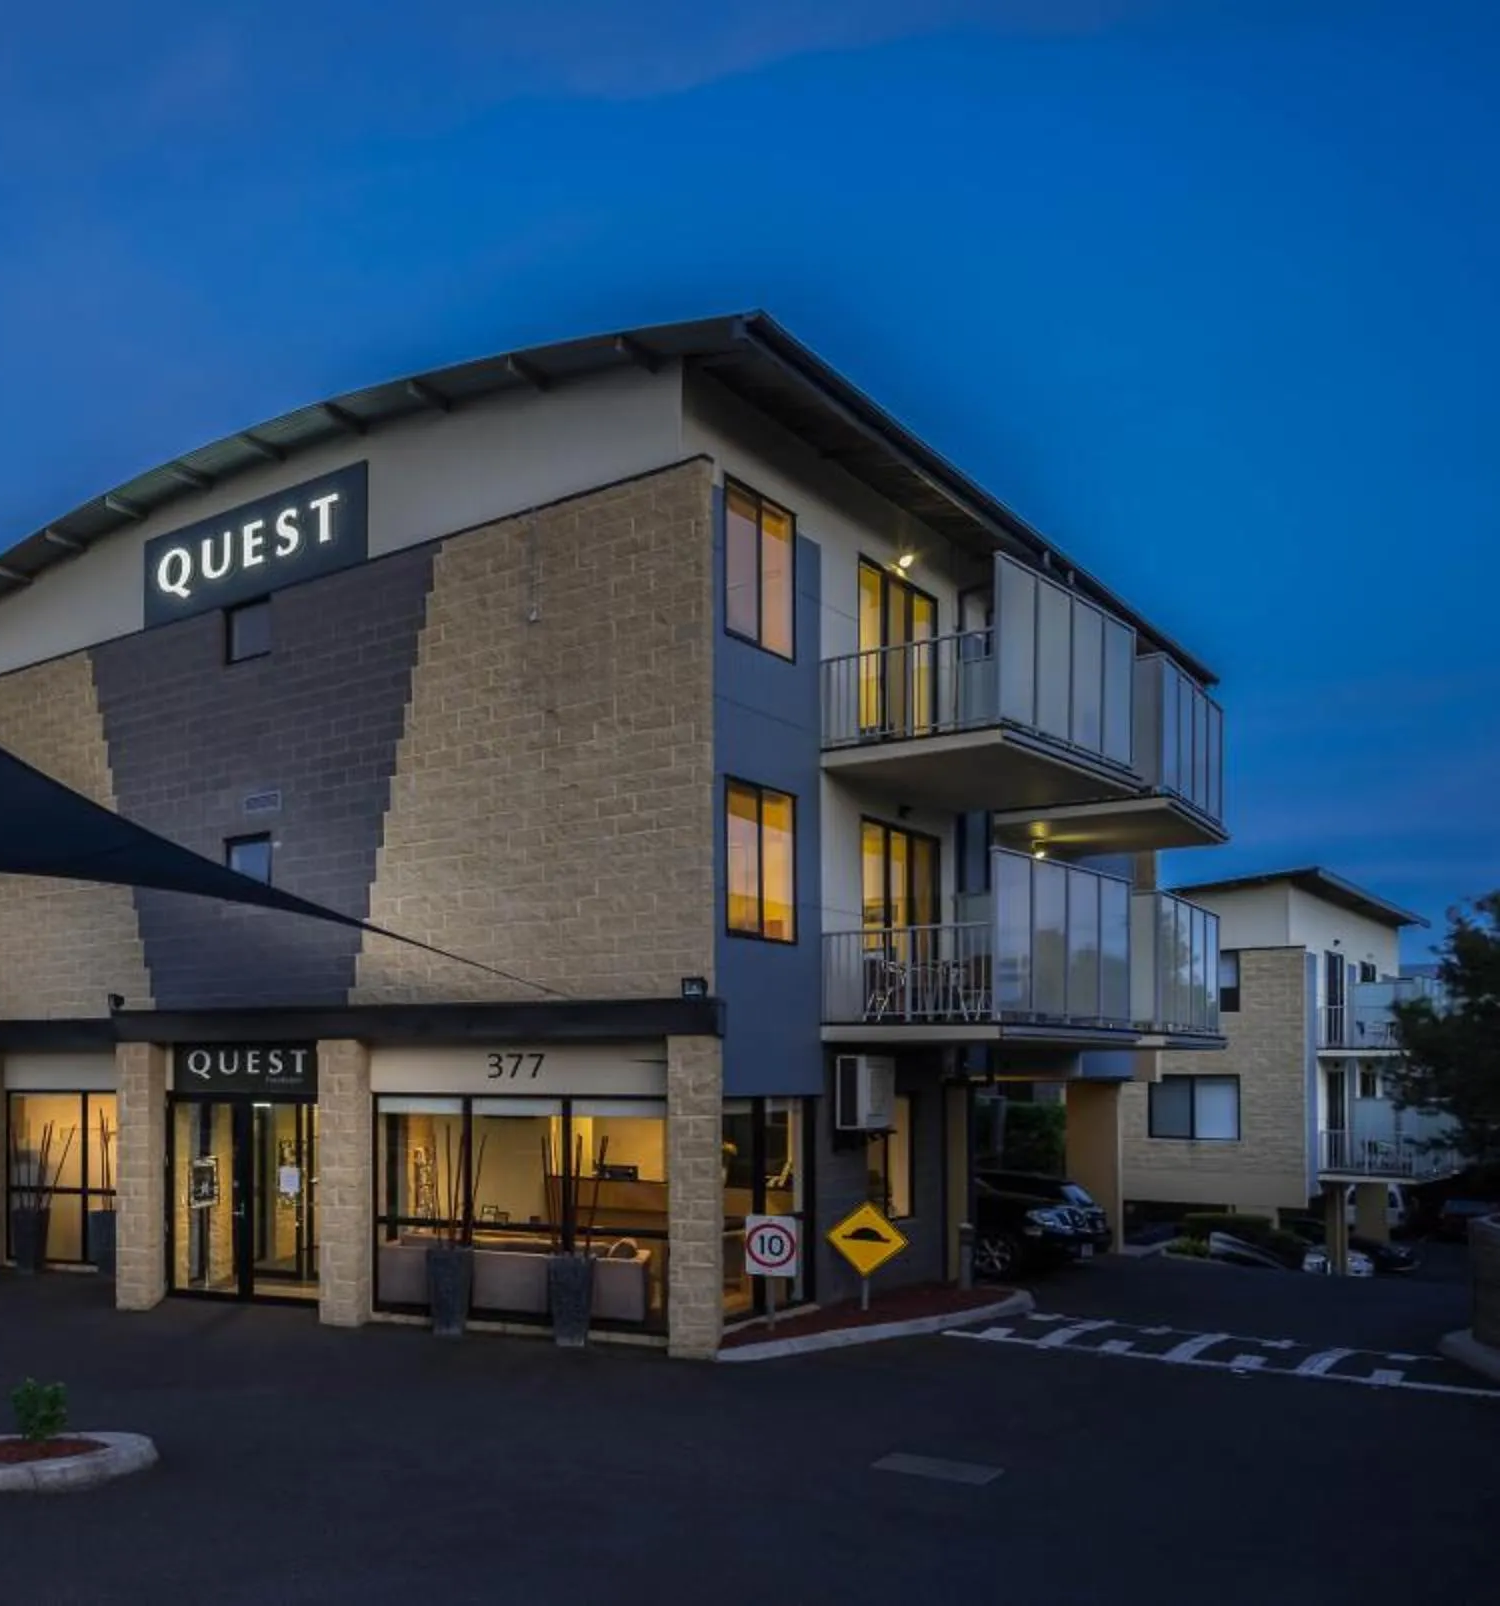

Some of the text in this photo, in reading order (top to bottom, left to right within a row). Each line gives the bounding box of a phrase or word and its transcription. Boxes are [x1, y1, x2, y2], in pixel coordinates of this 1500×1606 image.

[157, 493, 339, 598] QUEST
[187, 1050, 308, 1079] QUEST
[487, 1053, 546, 1079] 377
[760, 1234, 784, 1257] 10
